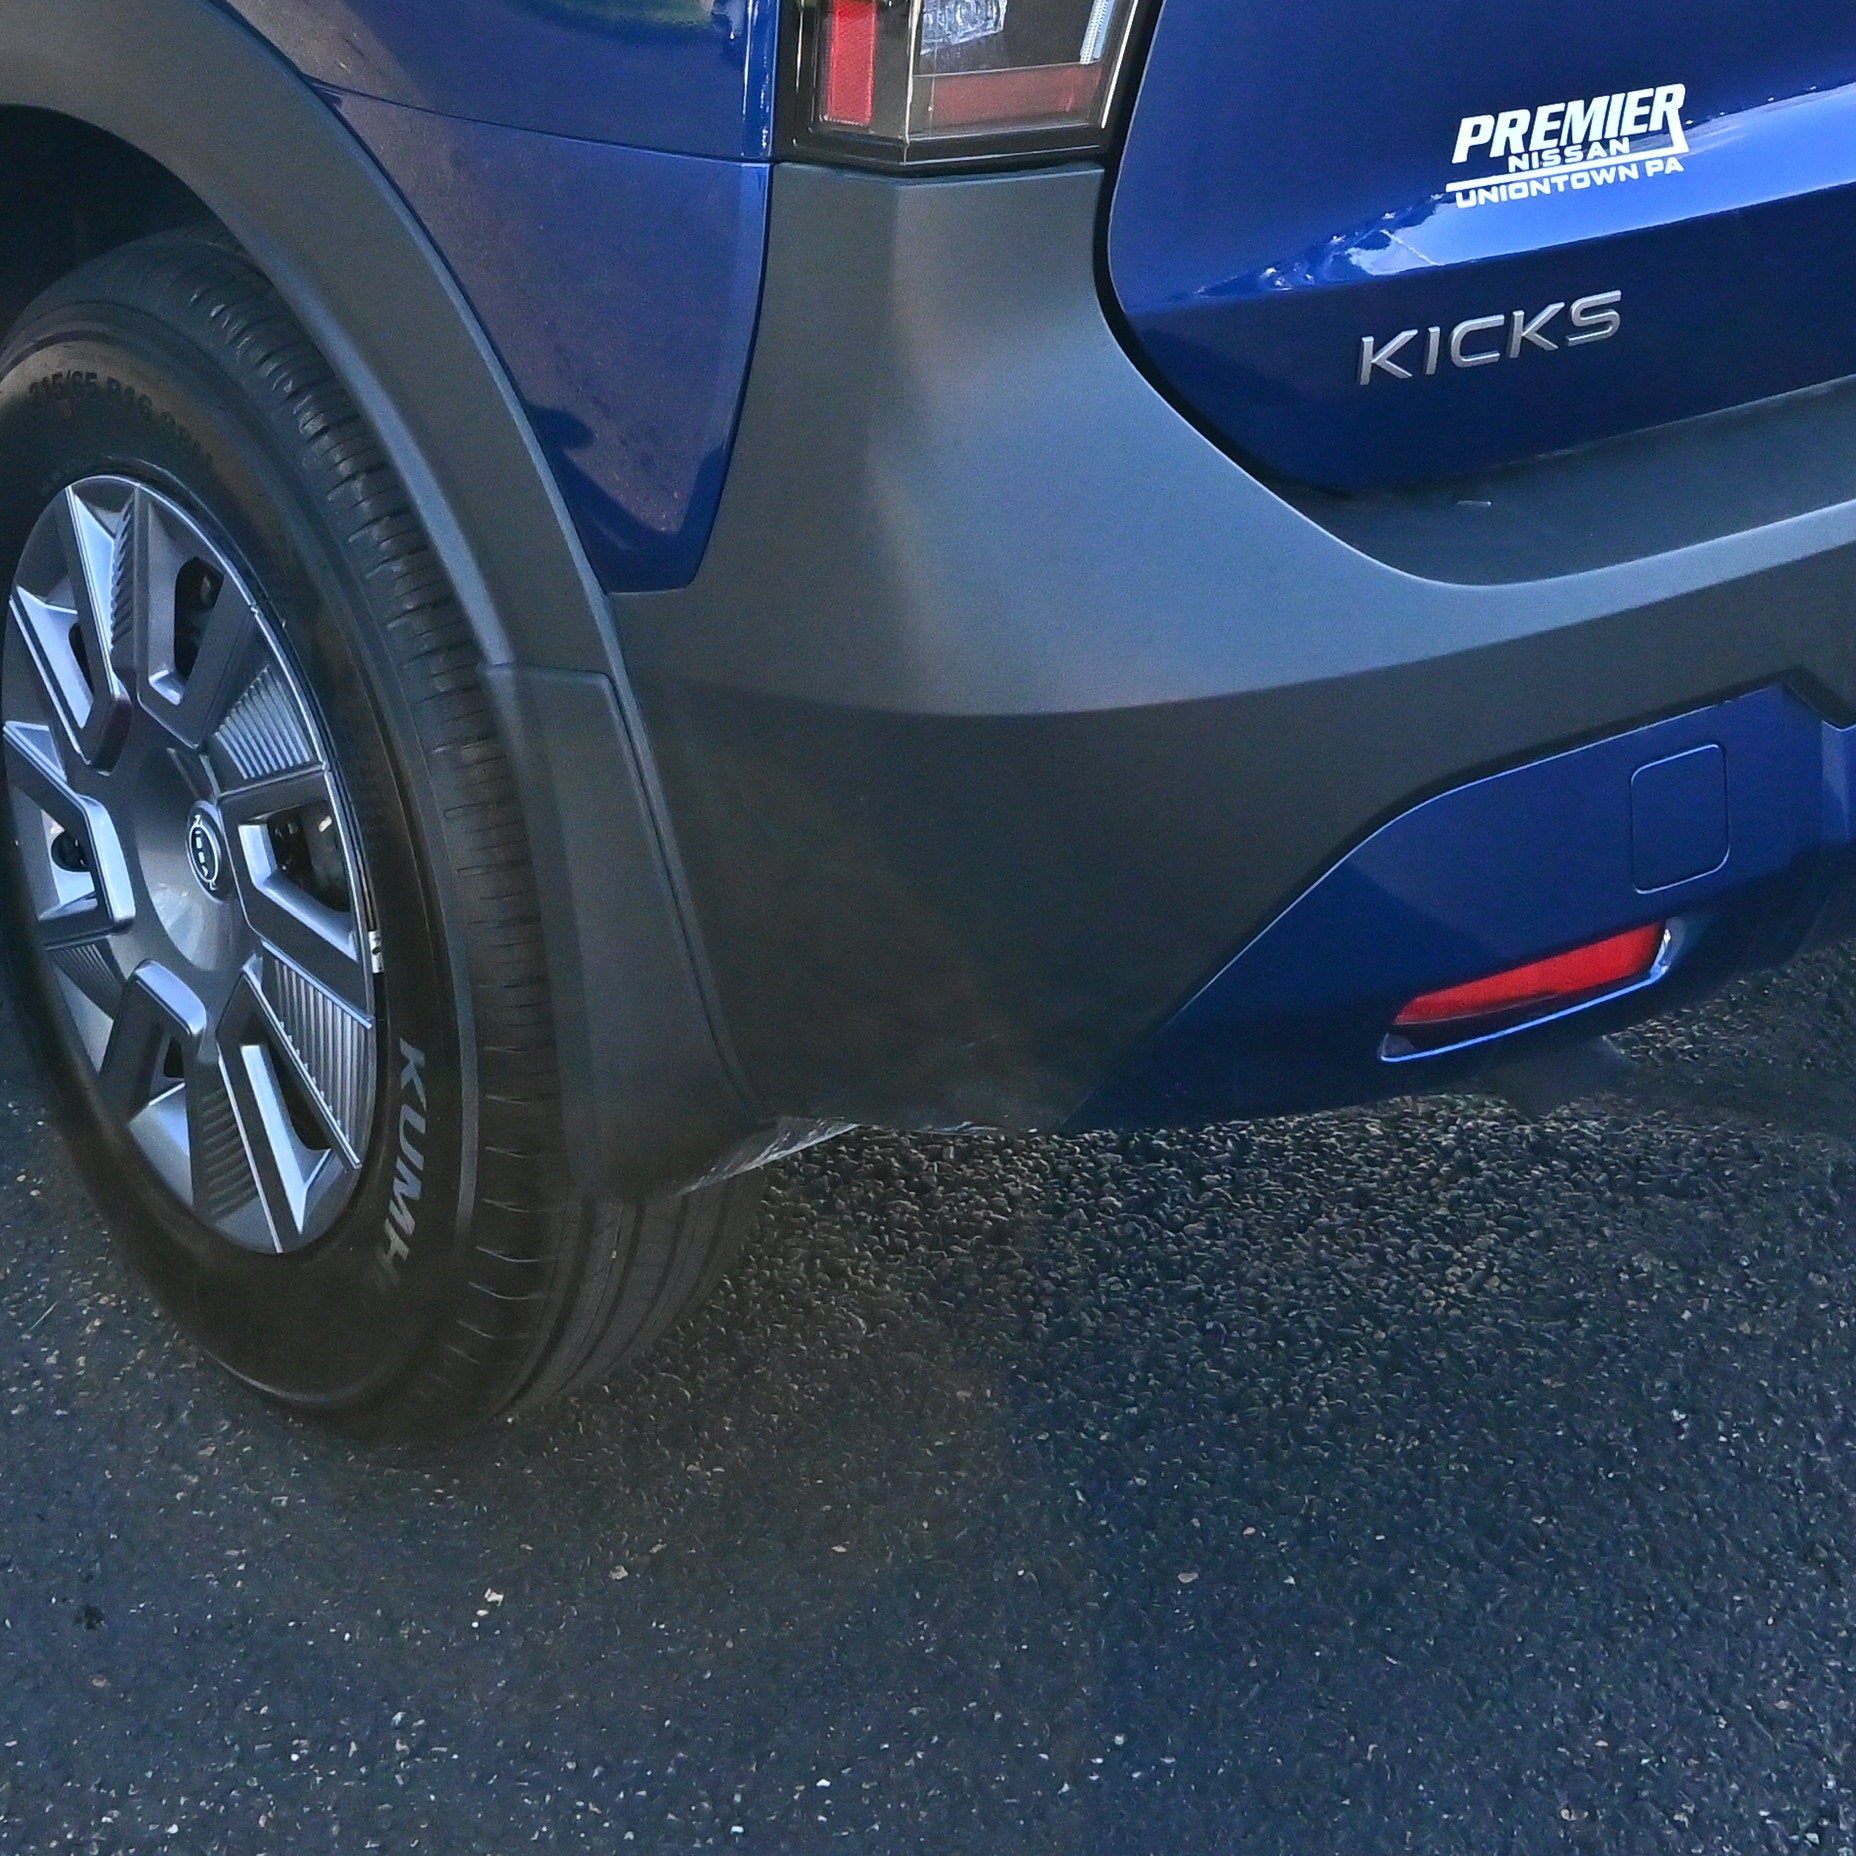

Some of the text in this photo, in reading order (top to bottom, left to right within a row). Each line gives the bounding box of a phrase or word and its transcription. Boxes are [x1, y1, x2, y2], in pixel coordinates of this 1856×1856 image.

[1450, 82, 1689, 165] PREMIER
[1508, 136, 1632, 173] NISSAN
[1455, 156, 1685, 209] UNIONTOWN PA
[1358, 289, 1622, 386] KICKS
